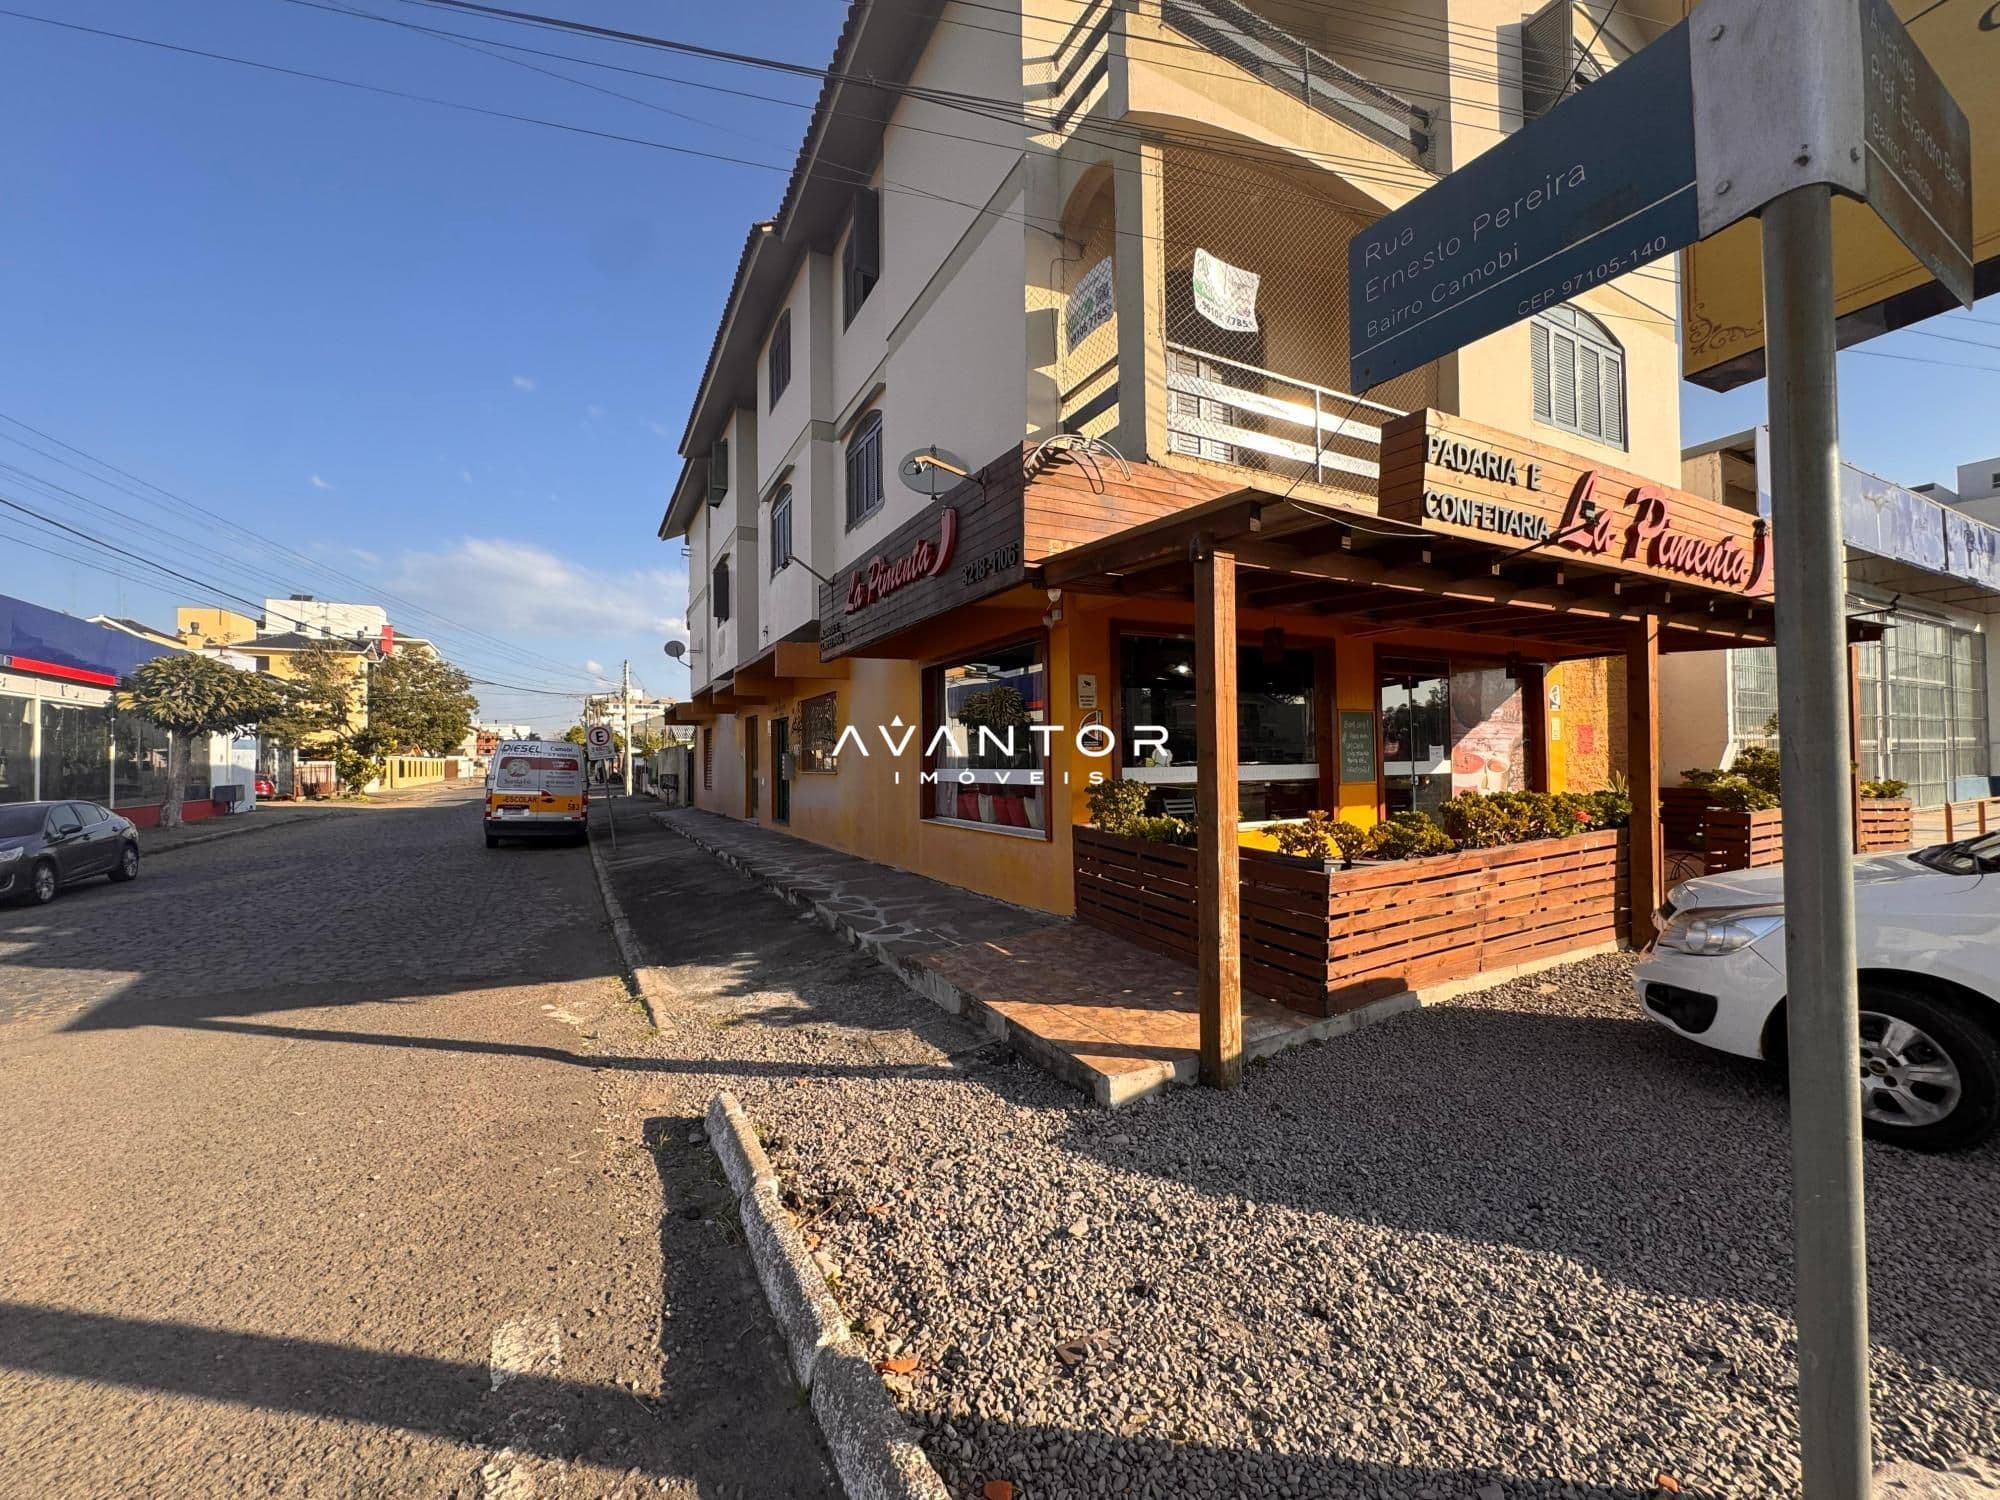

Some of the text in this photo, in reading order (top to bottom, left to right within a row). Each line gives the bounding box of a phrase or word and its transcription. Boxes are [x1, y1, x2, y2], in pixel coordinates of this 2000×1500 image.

[1870, 7, 1916, 91] Avenida
[1872, 113, 1899, 162] Bairro
[1365, 163, 1587, 304] Ernesto Pereira
[1365, 229, 1415, 268] Rua
[1367, 245, 1520, 338] Bairro Camobi
[1518, 237, 1667, 316] CEP 97105-140
[1427, 434, 1543, 491] PADARIA E
[1425, 490, 1551, 541] CONFEITARIA
[1557, 470, 1750, 586] La Pimenta
[845, 540, 931, 613] La Pimenta
